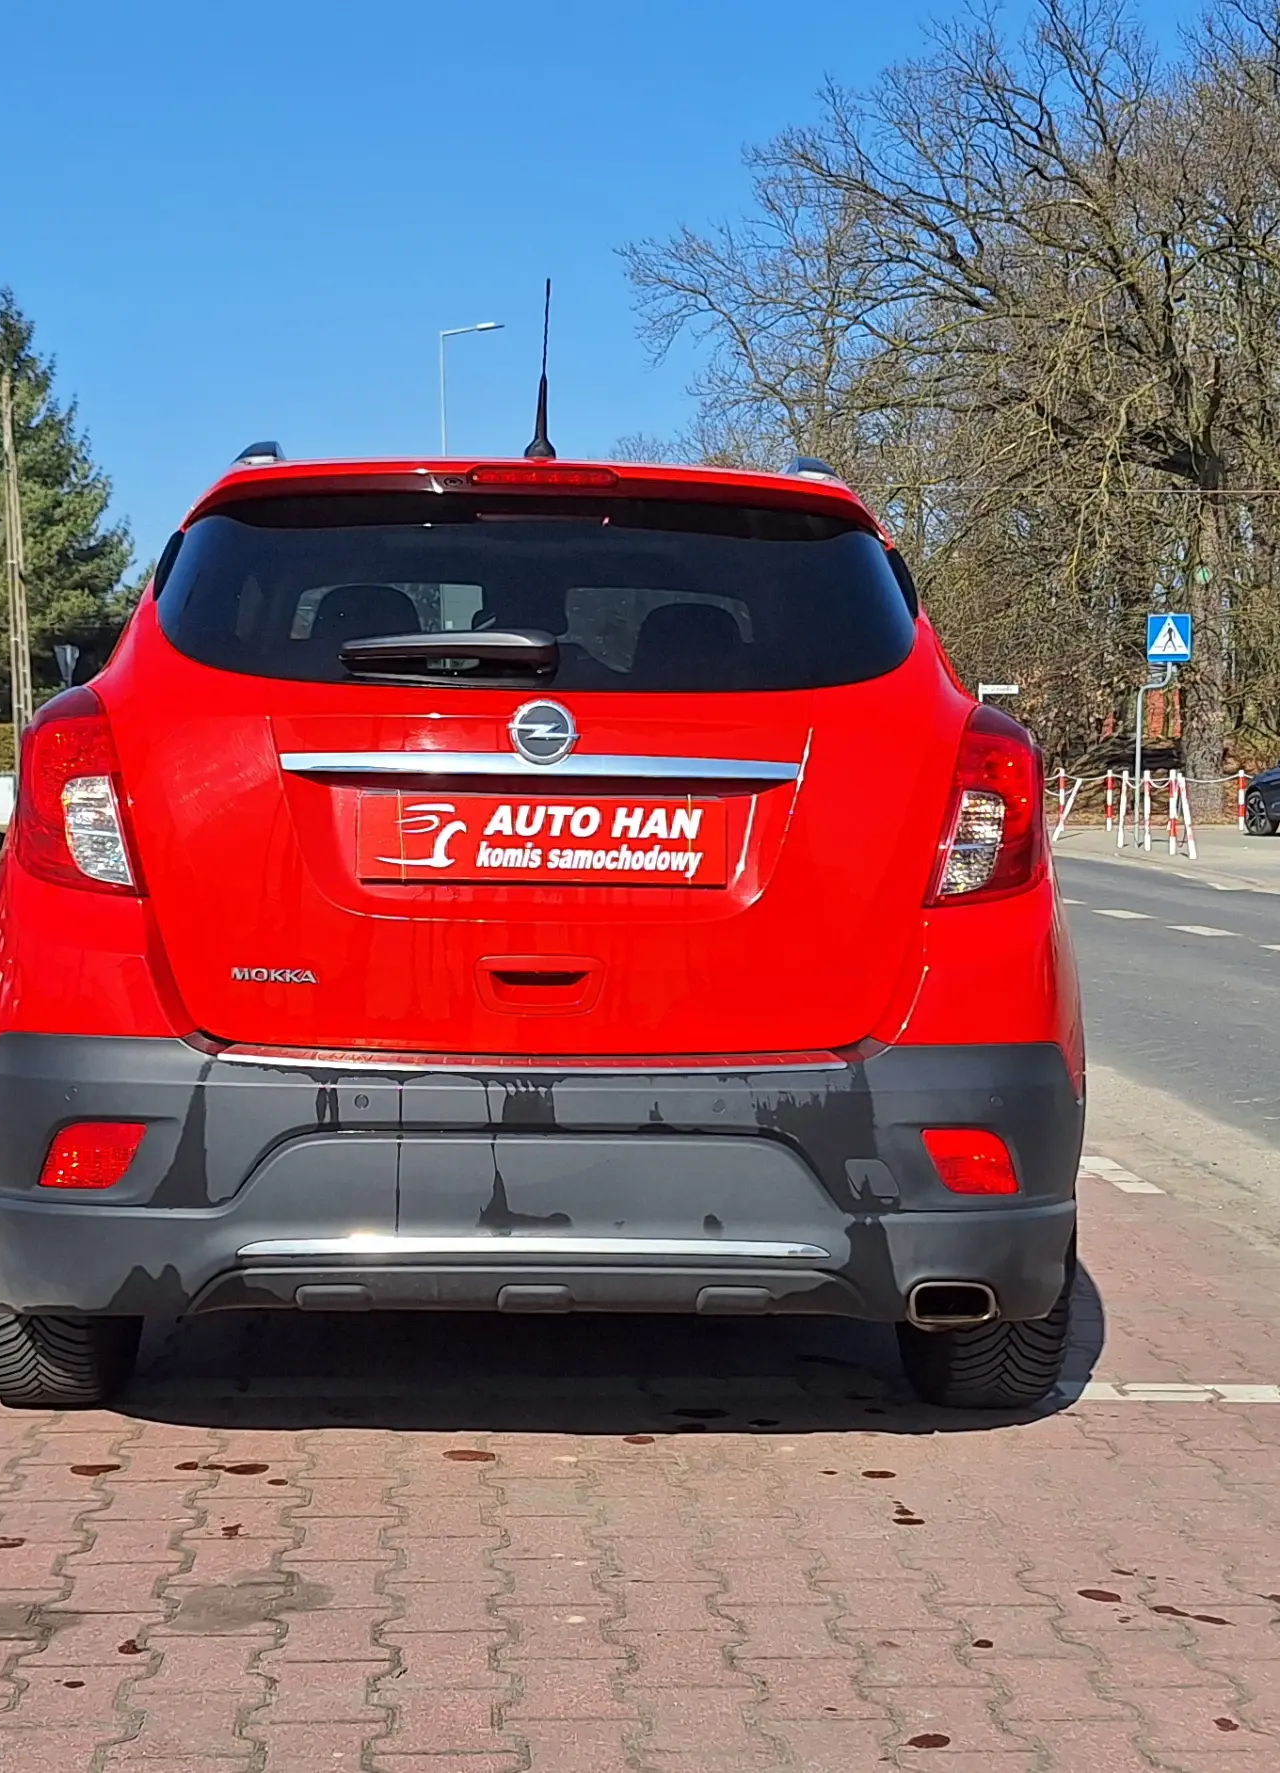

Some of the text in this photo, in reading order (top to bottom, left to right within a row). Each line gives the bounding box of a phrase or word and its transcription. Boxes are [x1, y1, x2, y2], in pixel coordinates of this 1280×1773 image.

[482, 805, 703, 840] AUTO HAN
[475, 840, 703, 878] komis samochodowy
[231, 967, 318, 984] MOKKA
